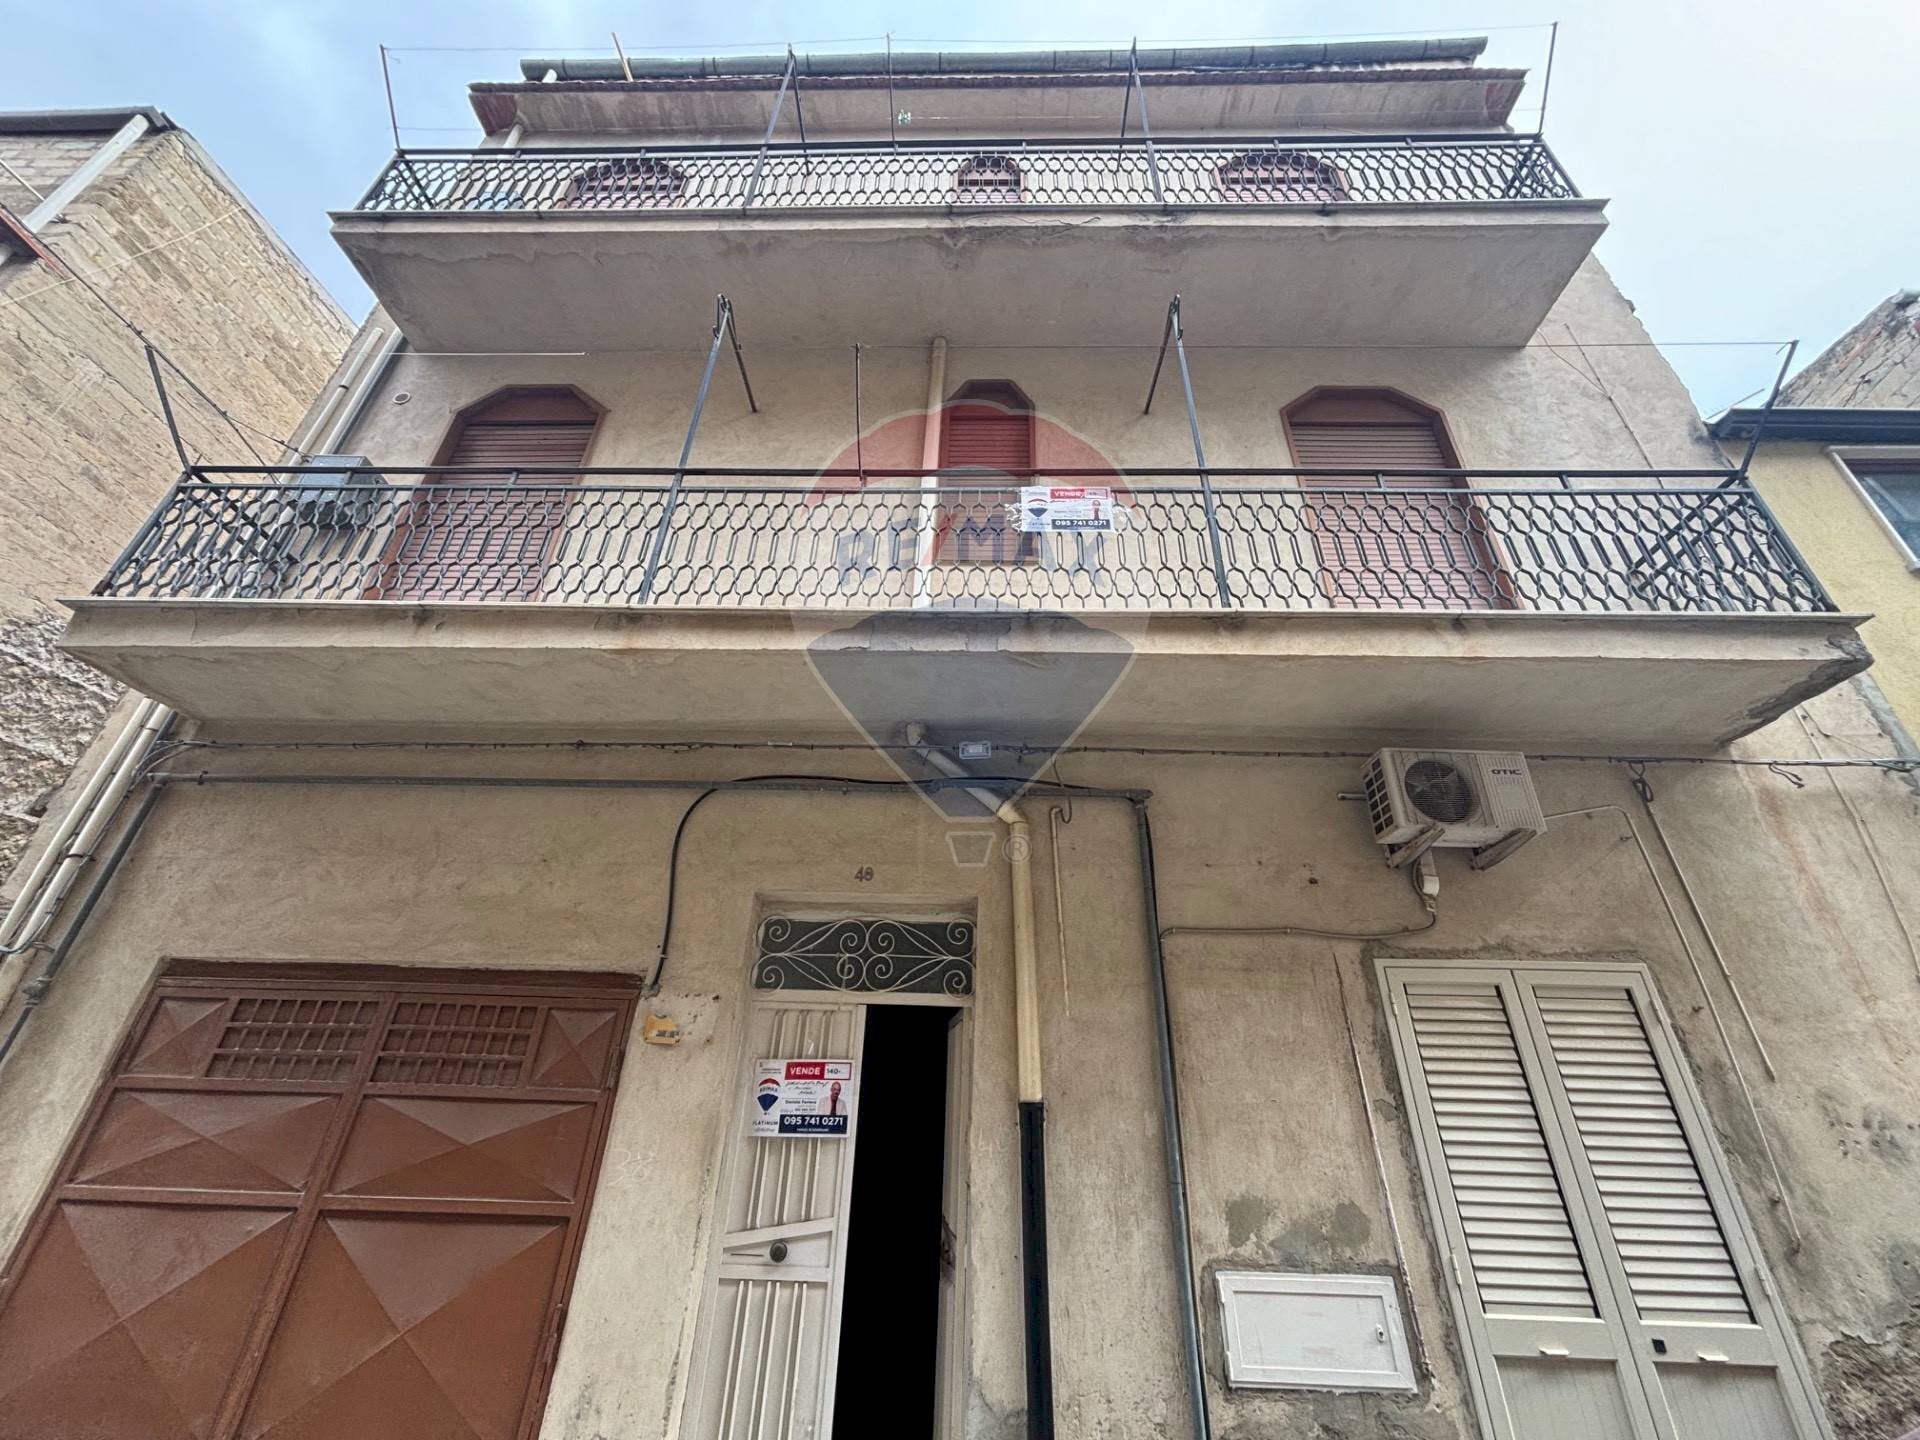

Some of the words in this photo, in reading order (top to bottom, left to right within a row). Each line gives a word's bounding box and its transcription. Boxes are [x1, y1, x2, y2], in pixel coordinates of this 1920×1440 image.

[790, 1067, 821, 1076] VENDE
[804, 1117, 819, 1125] 741
[822, 1117, 843, 1126] 0271
